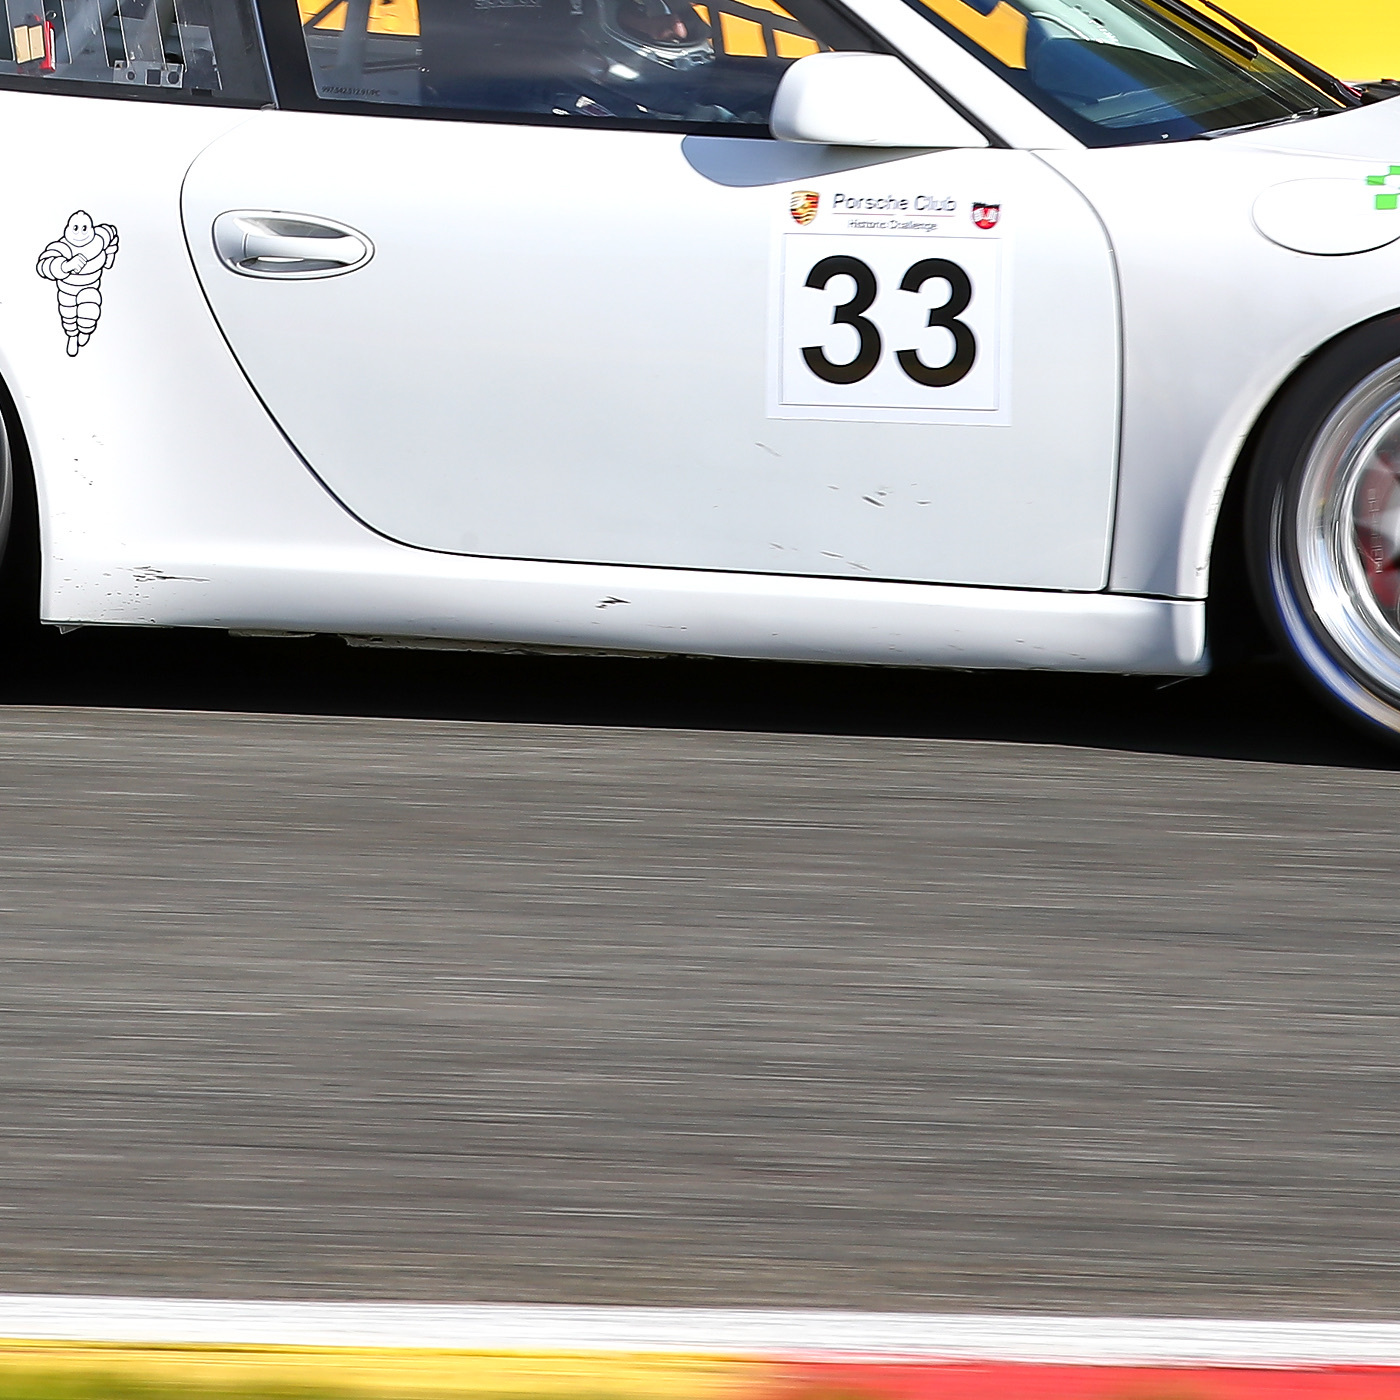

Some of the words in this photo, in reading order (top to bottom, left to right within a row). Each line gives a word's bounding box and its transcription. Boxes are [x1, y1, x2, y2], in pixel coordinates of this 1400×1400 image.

[832, 192, 909, 210] Porsche
[913, 194, 957, 212] Club
[800, 255, 977, 387] 33
